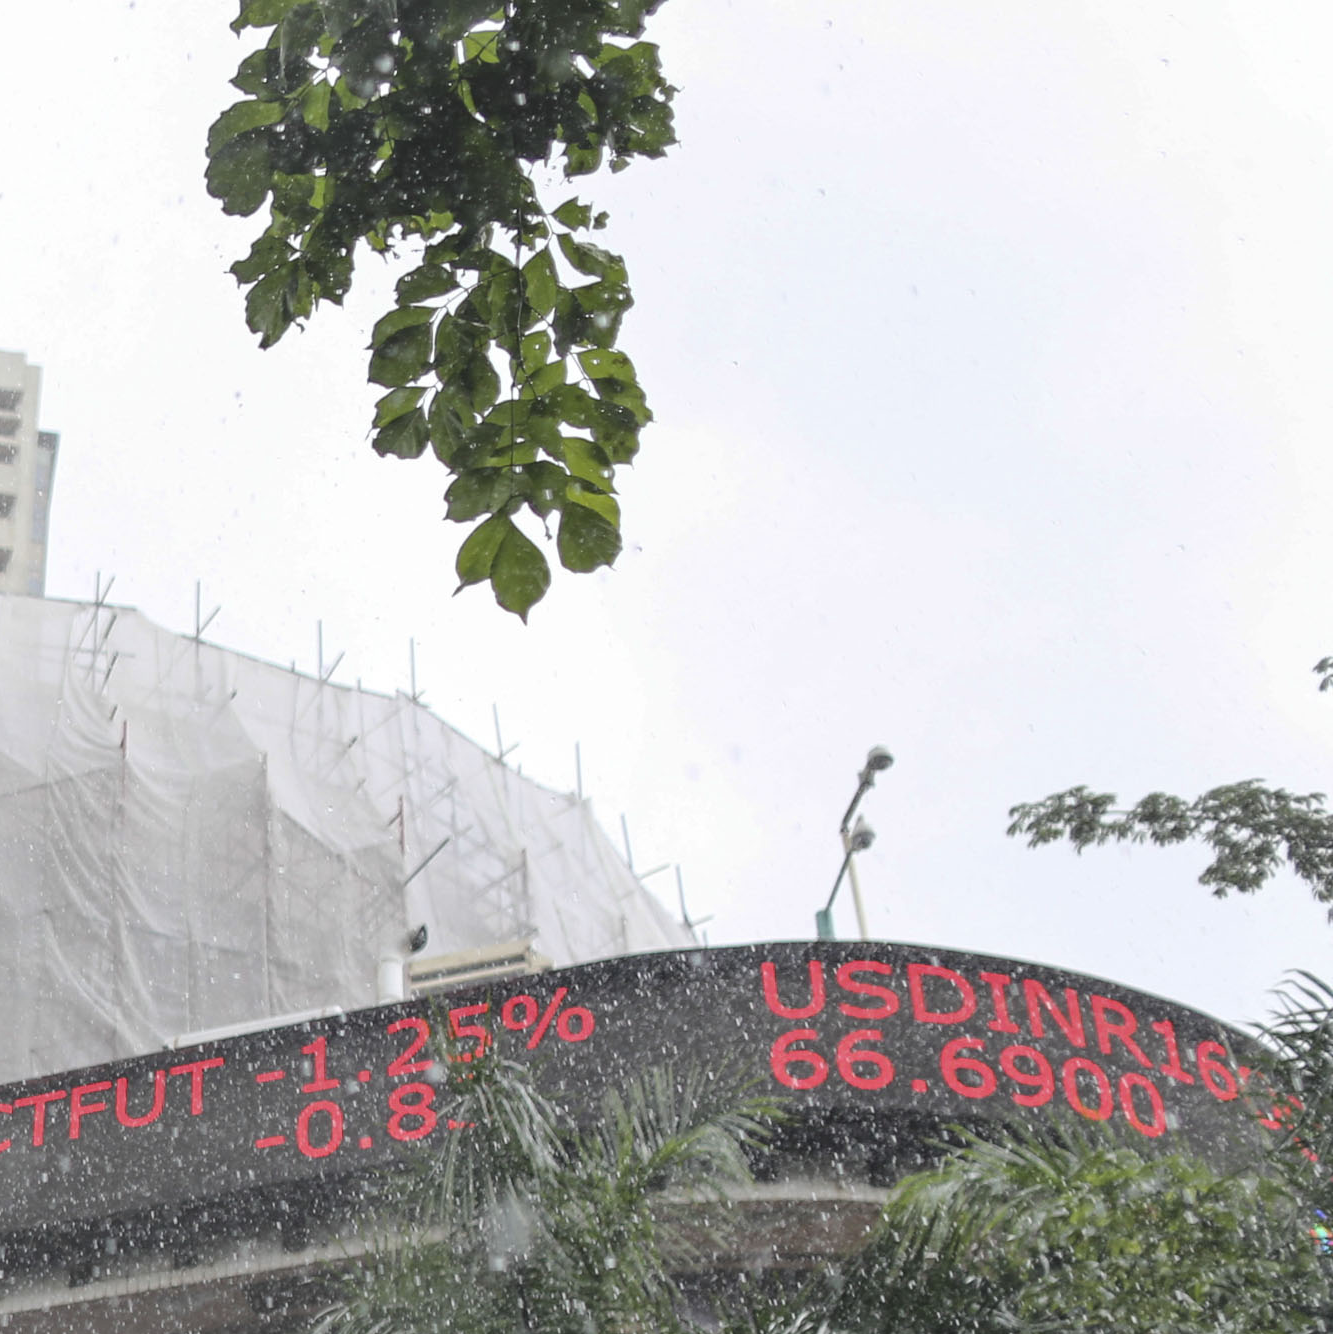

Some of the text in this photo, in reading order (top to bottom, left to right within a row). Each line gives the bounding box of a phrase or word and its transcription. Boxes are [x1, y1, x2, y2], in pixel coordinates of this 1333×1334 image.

[256, 986, 596, 1094] -1.25%
[769, 1029, 1167, 1138] 66.6900
[255, 1082, 476, 1159] -0.8
